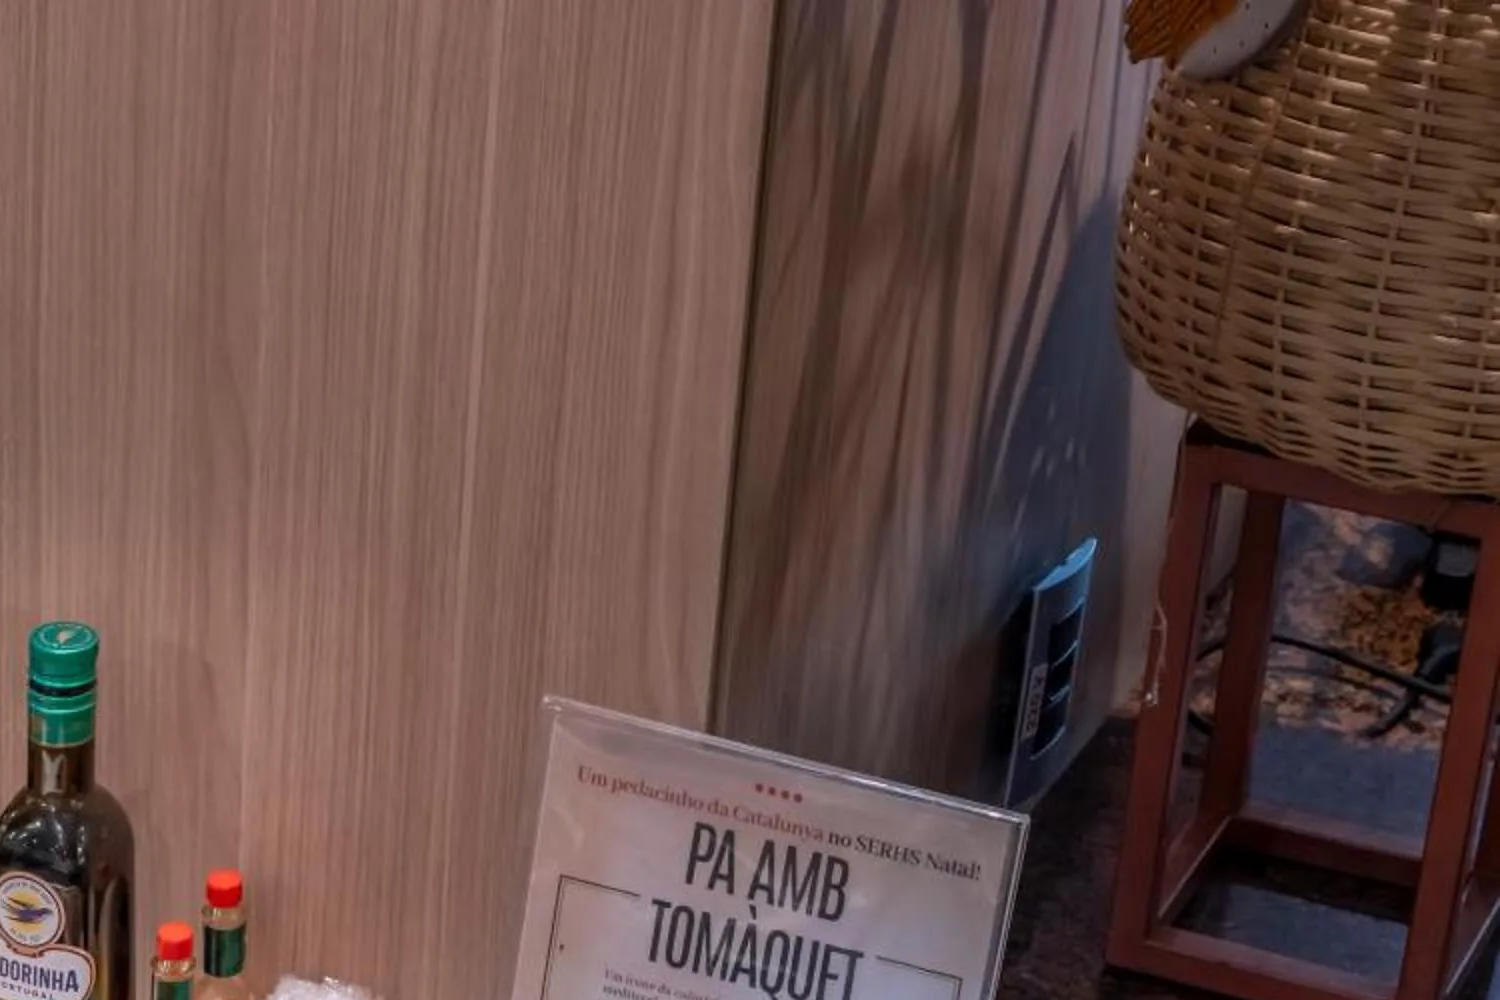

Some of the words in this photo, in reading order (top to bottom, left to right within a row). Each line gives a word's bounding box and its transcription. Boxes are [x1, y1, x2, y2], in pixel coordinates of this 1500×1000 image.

[578, 765, 607, 786] Um
[611, 777, 704, 811] pedacinho
[707, 799, 729, 818] da
[734, 805, 823, 843] Catalunya
[828, 831, 852, 848] no
[855, 835, 922, 865] SERHS
[926, 853, 981, 880] Natal!
[685, 822, 736, 896] PA
[748, 841, 850, 922] AMB
